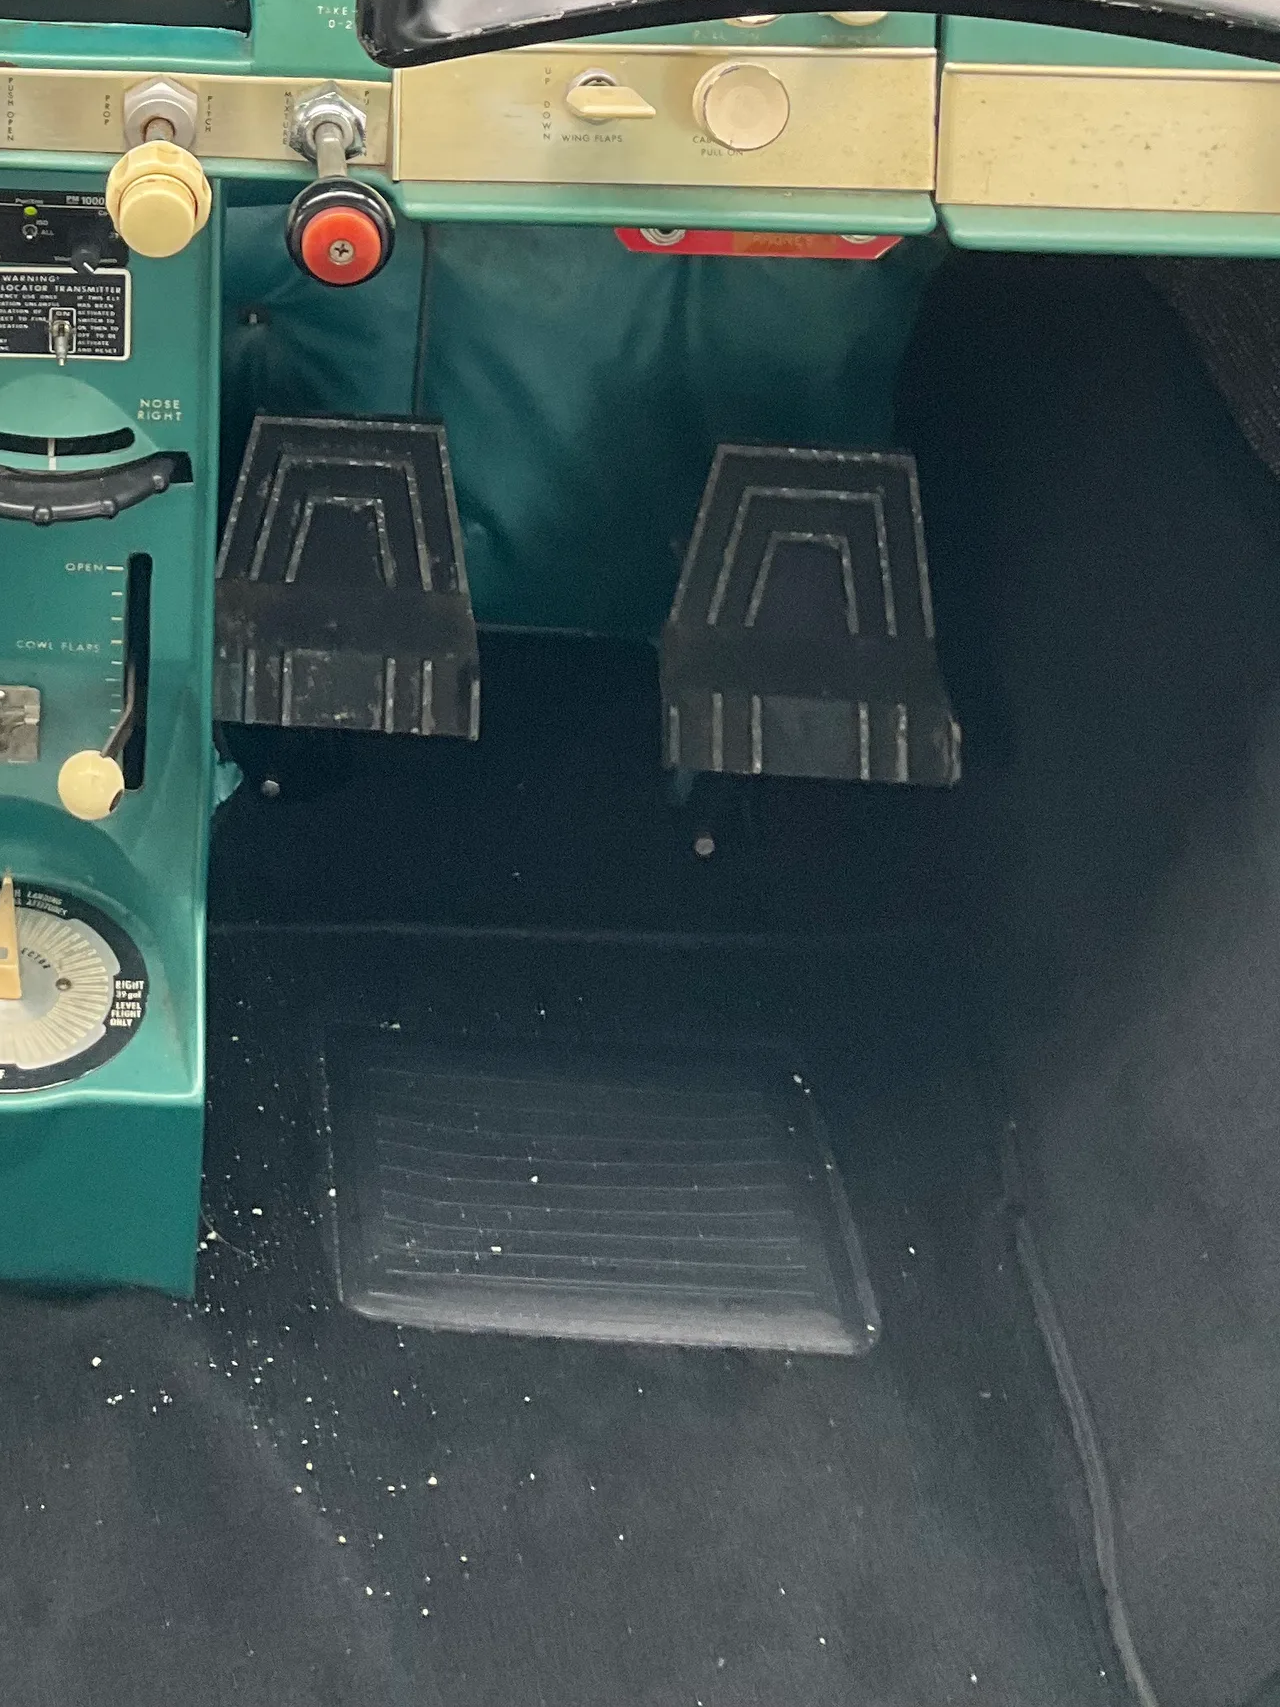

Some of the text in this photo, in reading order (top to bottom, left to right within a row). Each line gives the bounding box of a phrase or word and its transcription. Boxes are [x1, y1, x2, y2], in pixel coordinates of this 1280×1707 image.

[561, 134, 623, 143] WING FLAPS
[701, 148, 724, 157] PULL
[81, 196, 105, 206] 1000
[1, 284, 121, 294] LOCATOR TRANSMITTER
[140, 399, 180, 410] NOSE
[137, 411, 183, 422] RIGHT
[65, 563, 104, 572] OPEN
[16, 640, 100, 654] COWL FLAPS
[115, 980, 144, 990] RIGHT
[115, 1002, 142, 1010] LEVEL
[111, 1010, 141, 1018] FLIGHT
